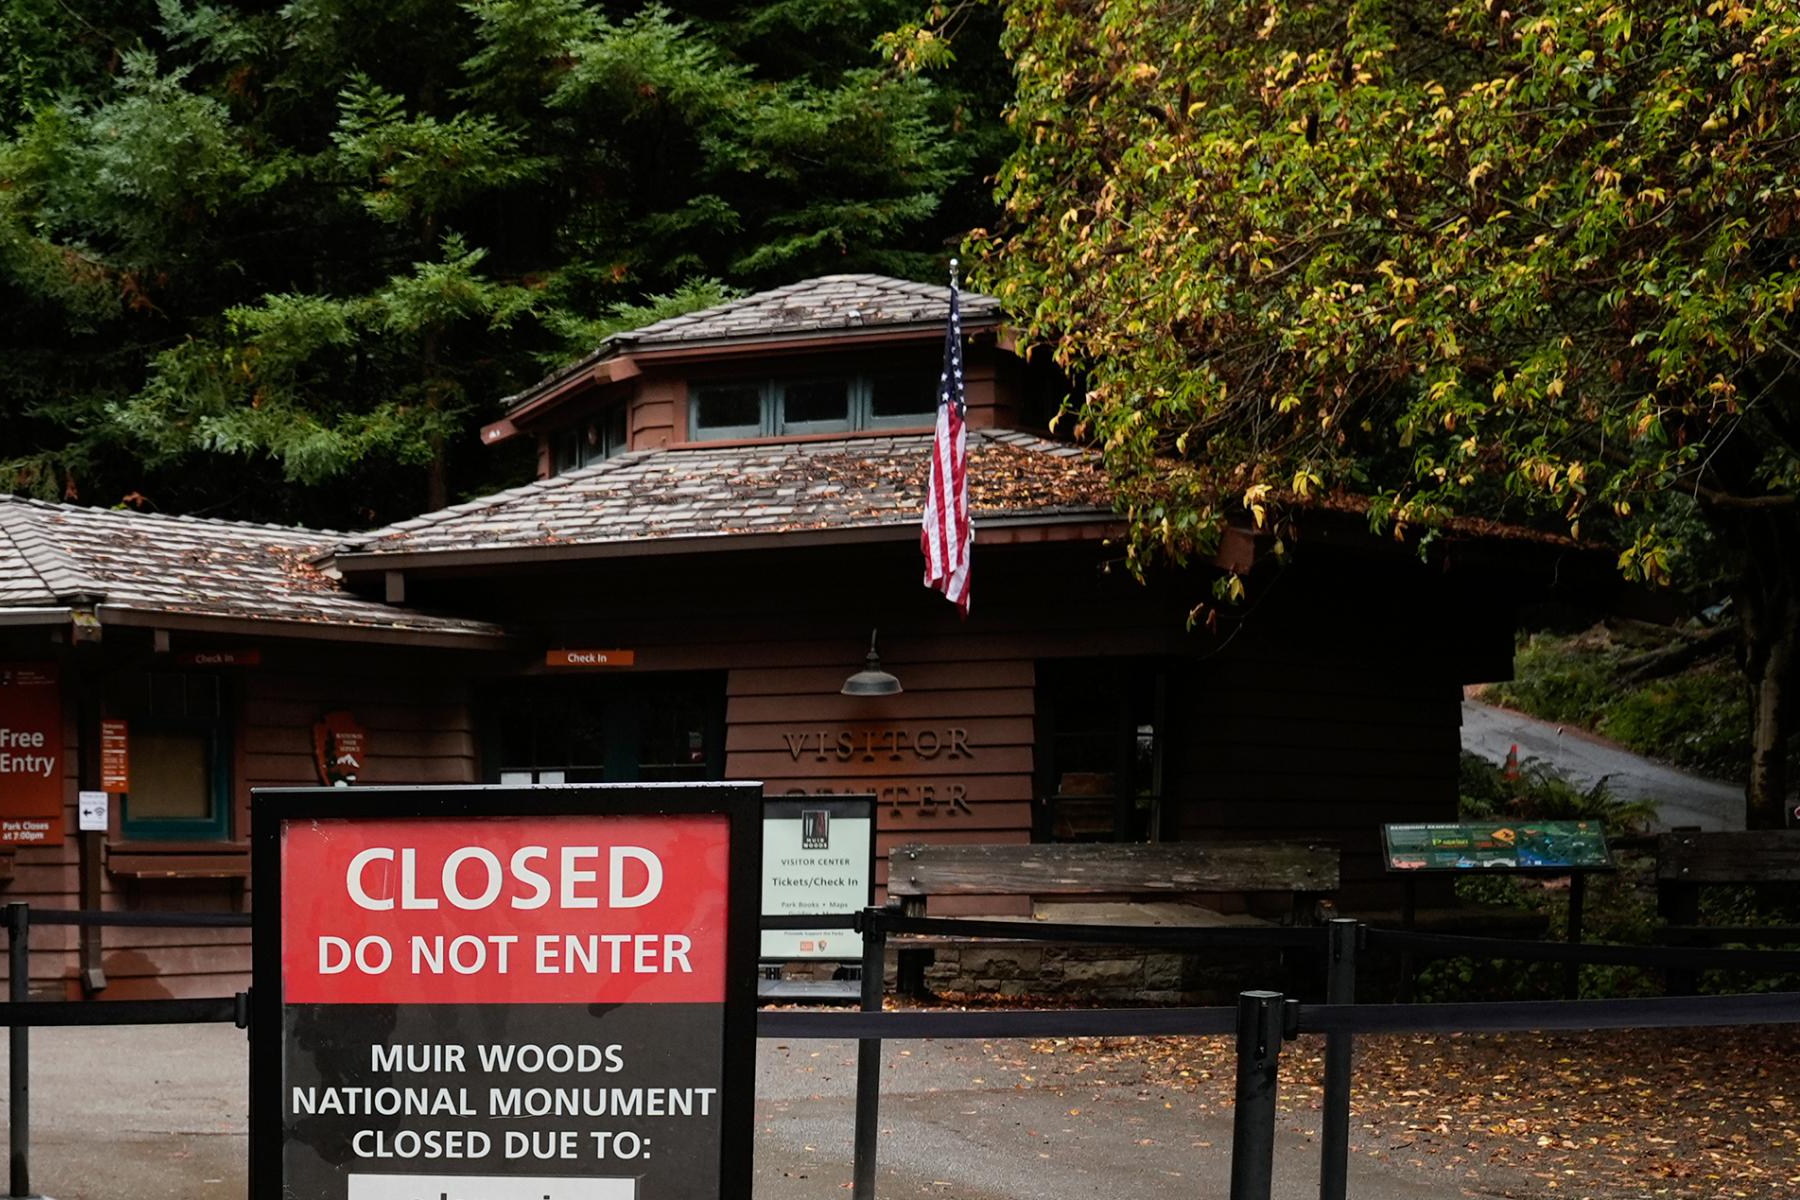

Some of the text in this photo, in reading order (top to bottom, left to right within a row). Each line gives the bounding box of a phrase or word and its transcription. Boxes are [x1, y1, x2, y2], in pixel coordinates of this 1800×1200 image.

[196, 654, 234, 664] Check In
[568, 653, 607, 663] Check In
[0, 728, 44, 747] Free
[784, 727, 974, 761] VISITOR
[0, 753, 55, 778] Entry
[786, 784, 973, 816] TER
[3, 821, 49, 831] Park Closes
[3, 831, 12, 840] at
[781, 858, 850, 866] VISITOR CENTER
[346, 846, 664, 910] CLOSED
[772, 877, 858, 888] Tickets/Check In
[829, 901, 848, 909] Maps
[318, 934, 693, 975] DO NOT ENTER
[371, 1044, 624, 1073] MUIR WOODS
[292, 1087, 717, 1117] NATIONAL MONUMENT
[352, 1130, 652, 1160] CLOSED DUE TO:
